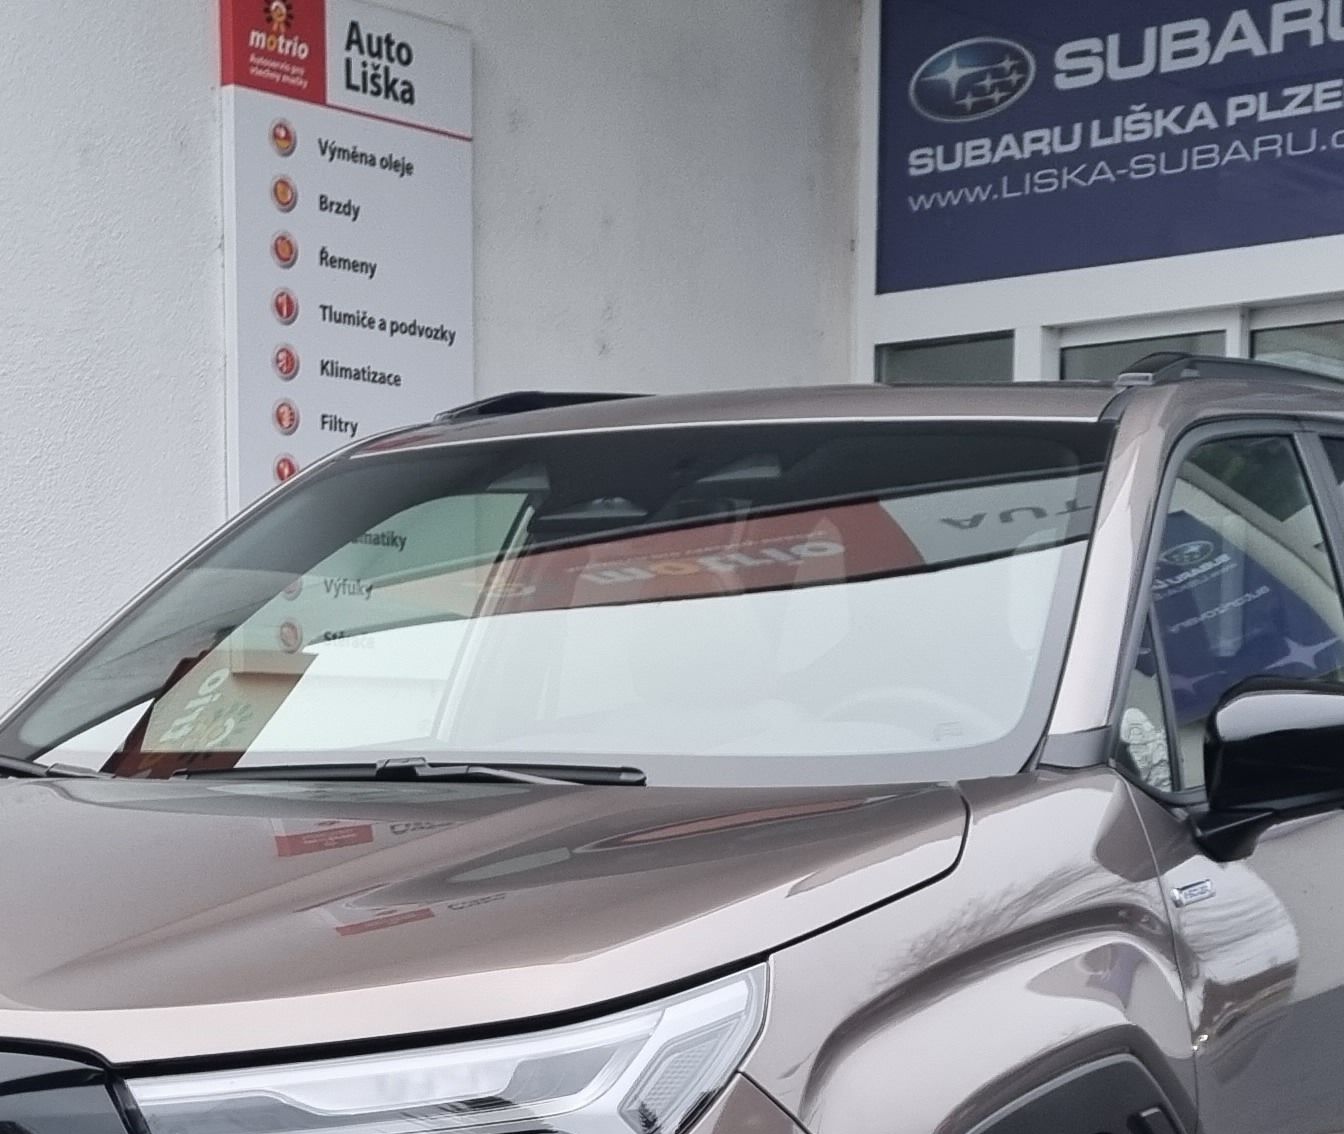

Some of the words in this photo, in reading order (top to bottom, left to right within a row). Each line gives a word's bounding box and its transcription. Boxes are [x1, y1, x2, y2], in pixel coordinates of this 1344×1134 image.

[248, 29, 310, 61] motrio
[344, 19, 414, 67] Auto
[345, 57, 416, 106] Liška
[317, 137, 377, 169] Výměna
[379, 152, 415, 177] oleje
[907, 122, 1083, 177] SUBARU
[1089, 104, 1220, 148] LIŠKA
[318, 194, 361, 223] Brzdy
[318, 244, 378, 279] Řemeny
[318, 304, 377, 332] Tlumiče
[378, 318, 388, 333] a
[389, 318, 457, 347] podvozky
[319, 358, 403, 388] Klimatizace
[319, 413, 359, 437] Filtry
[324, 579, 373, 600] Výfuky
